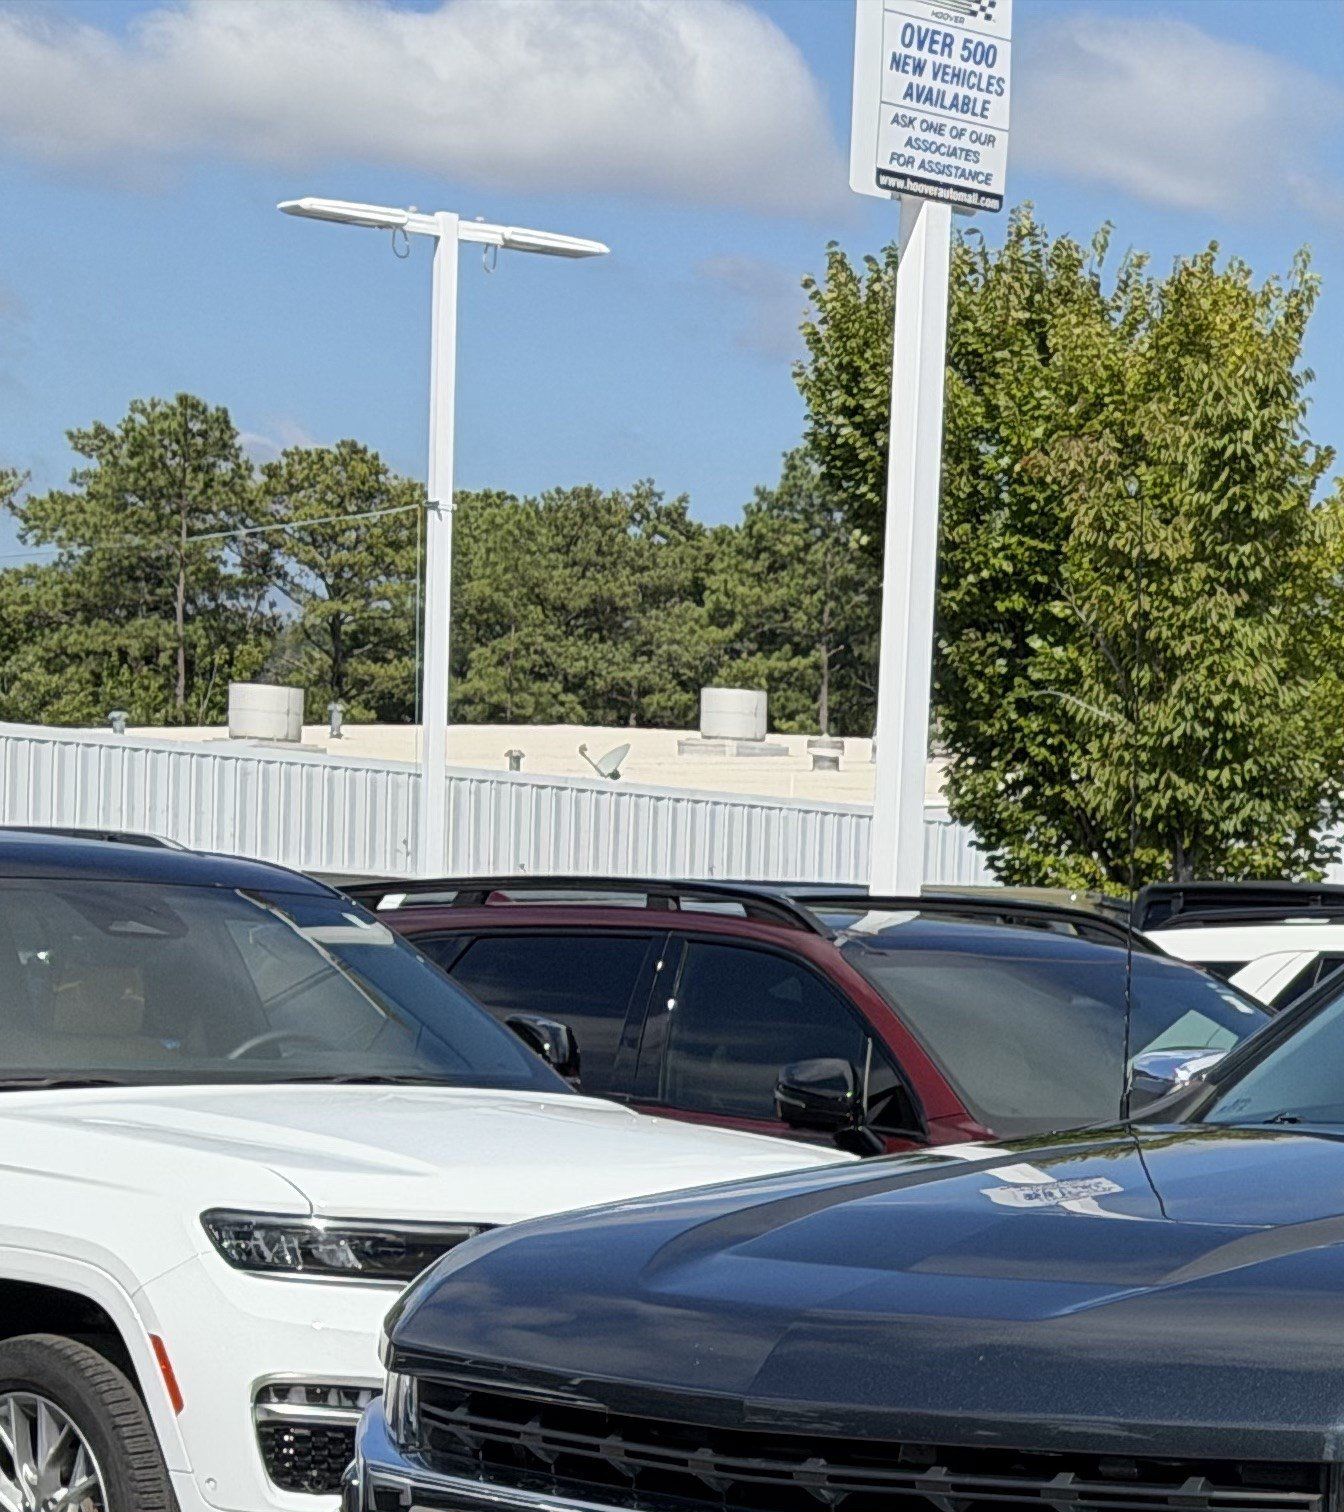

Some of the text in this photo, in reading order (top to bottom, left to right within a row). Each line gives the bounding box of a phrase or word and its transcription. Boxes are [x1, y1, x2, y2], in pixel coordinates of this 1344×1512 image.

[931, 10, 965, 24] HOOVER
[900, 22, 998, 69] OVER 500
[889, 51, 1006, 97] NEW VEHICLES
[902, 81, 991, 119] AVAILABLE
[890, 112, 997, 148] ASK ONE OF OUR
[904, 136, 981, 164] ASSOCIATES
[888, 151, 994, 186] FOR ASSISTANCE
[879, 174, 1000, 209] www.hooverautomall.com
